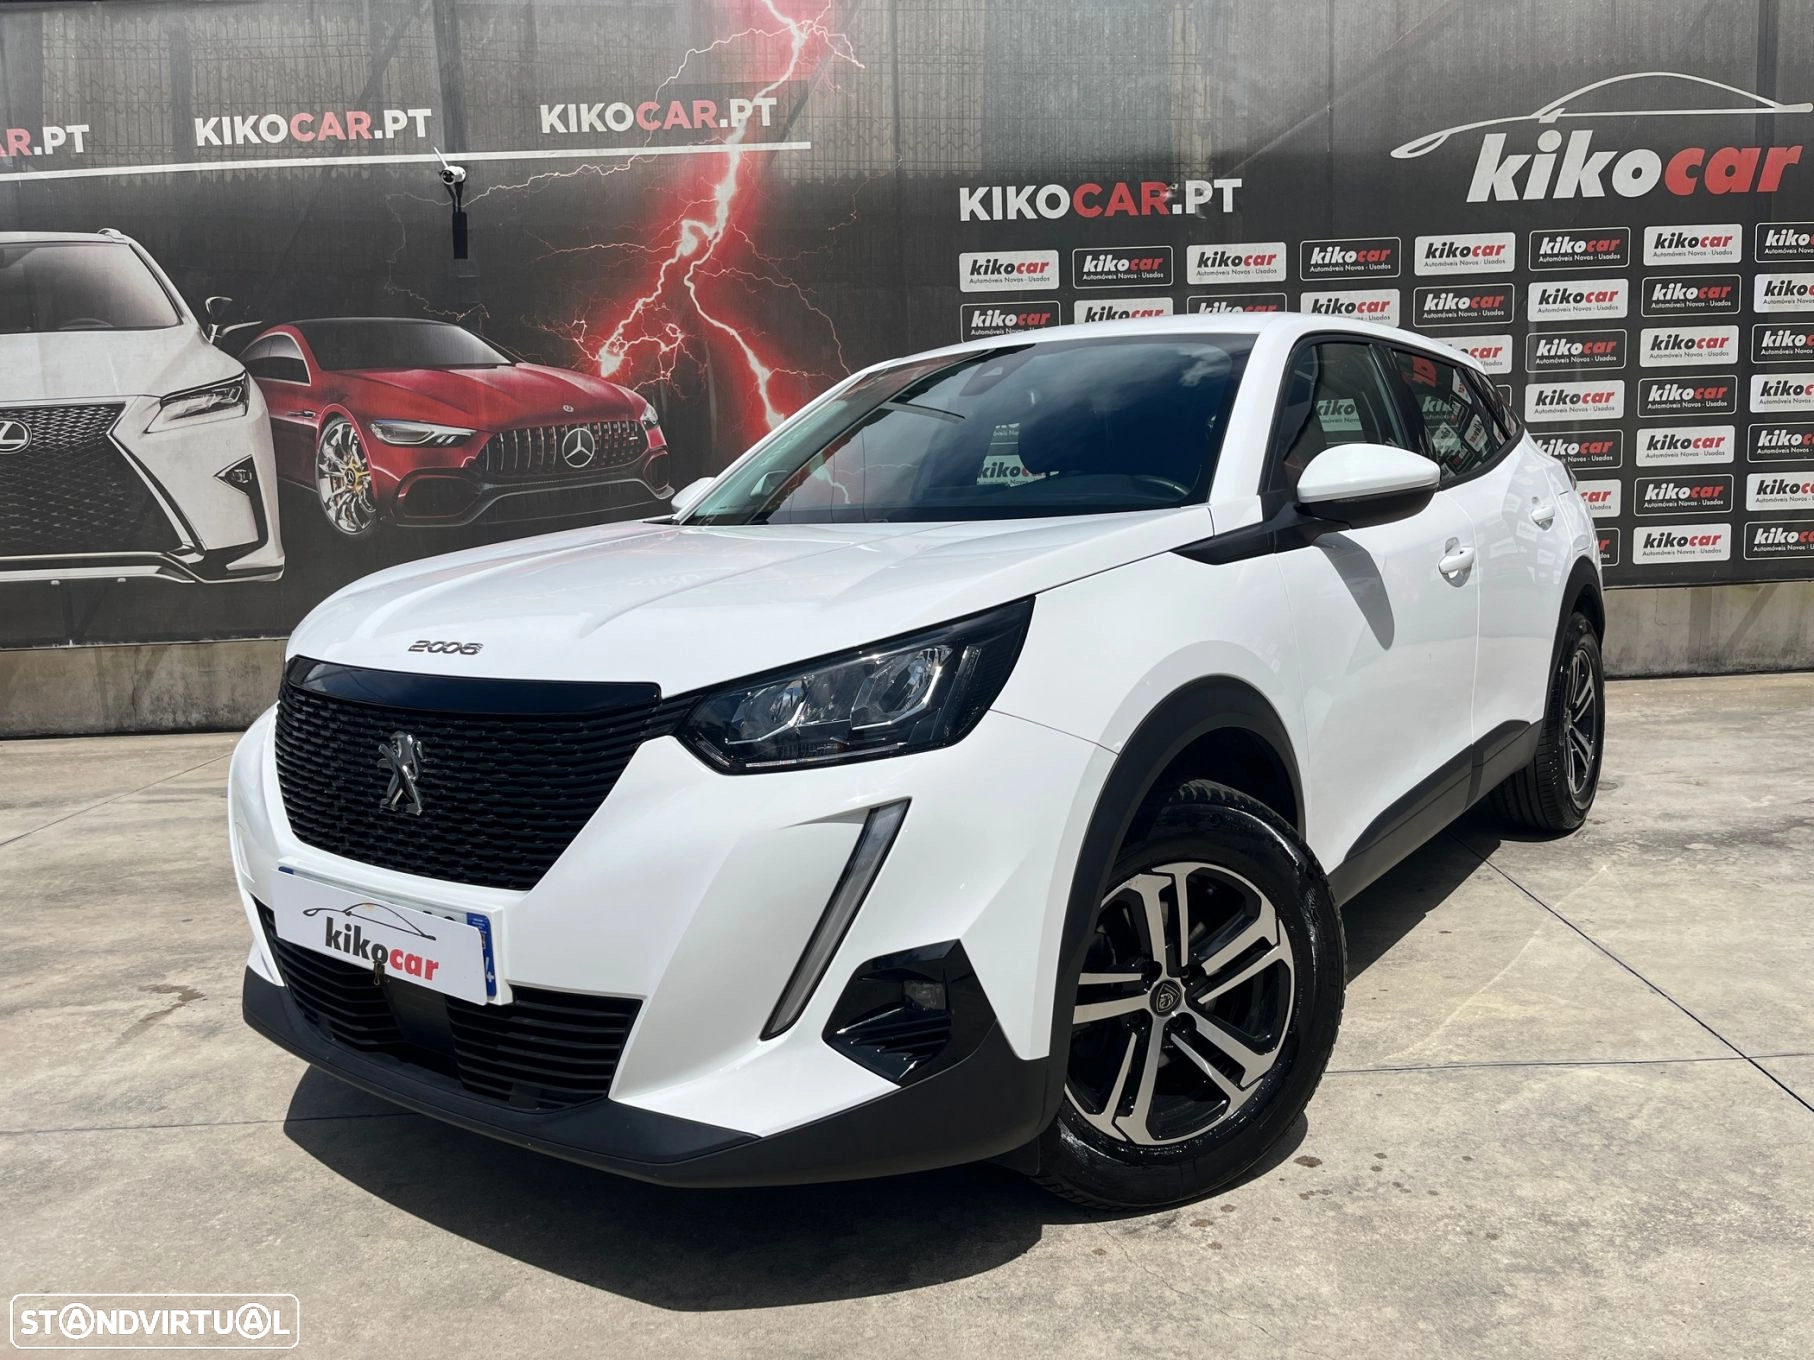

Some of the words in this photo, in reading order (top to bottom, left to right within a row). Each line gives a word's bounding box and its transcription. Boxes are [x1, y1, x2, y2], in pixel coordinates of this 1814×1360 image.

[540, 98, 777, 133] KIKOCAR.PT
[195, 109, 431, 146] KIKOCAR.PT
[1466, 130, 1803, 202] kikocar
[960, 178, 1242, 221] KIKOCAR.PT
[1539, 236, 1620, 254] kikocar
[1654, 233, 1733, 249] kikocar
[1310, 247, 1391, 264] kikocar
[1425, 242, 1505, 259] kikocar
[970, 259, 1049, 275] kikocar
[1083, 255, 1163, 272] kikocar
[1197, 251, 1277, 268] kikocar
[1538, 288, 1618, 305] kikocar
[1652, 283, 1732, 300] kikocar
[1312, 298, 1390, 315] kikocar
[1424, 293, 1504, 311] kikocar
[971, 310, 1051, 327] kikocar
[1536, 339, 1617, 356] kikocar
[1651, 334, 1729, 350] kikocar
[1535, 390, 1615, 406] kikocar
[1648, 384, 1728, 401] kikocar
[1647, 434, 1725, 451] kikocar
[1758, 430, 1814, 446] kikoc
[1645, 483, 1724, 500] kikocar
[1643, 533, 1721, 548] kikocar
[325, 917, 439, 981] kikocar
